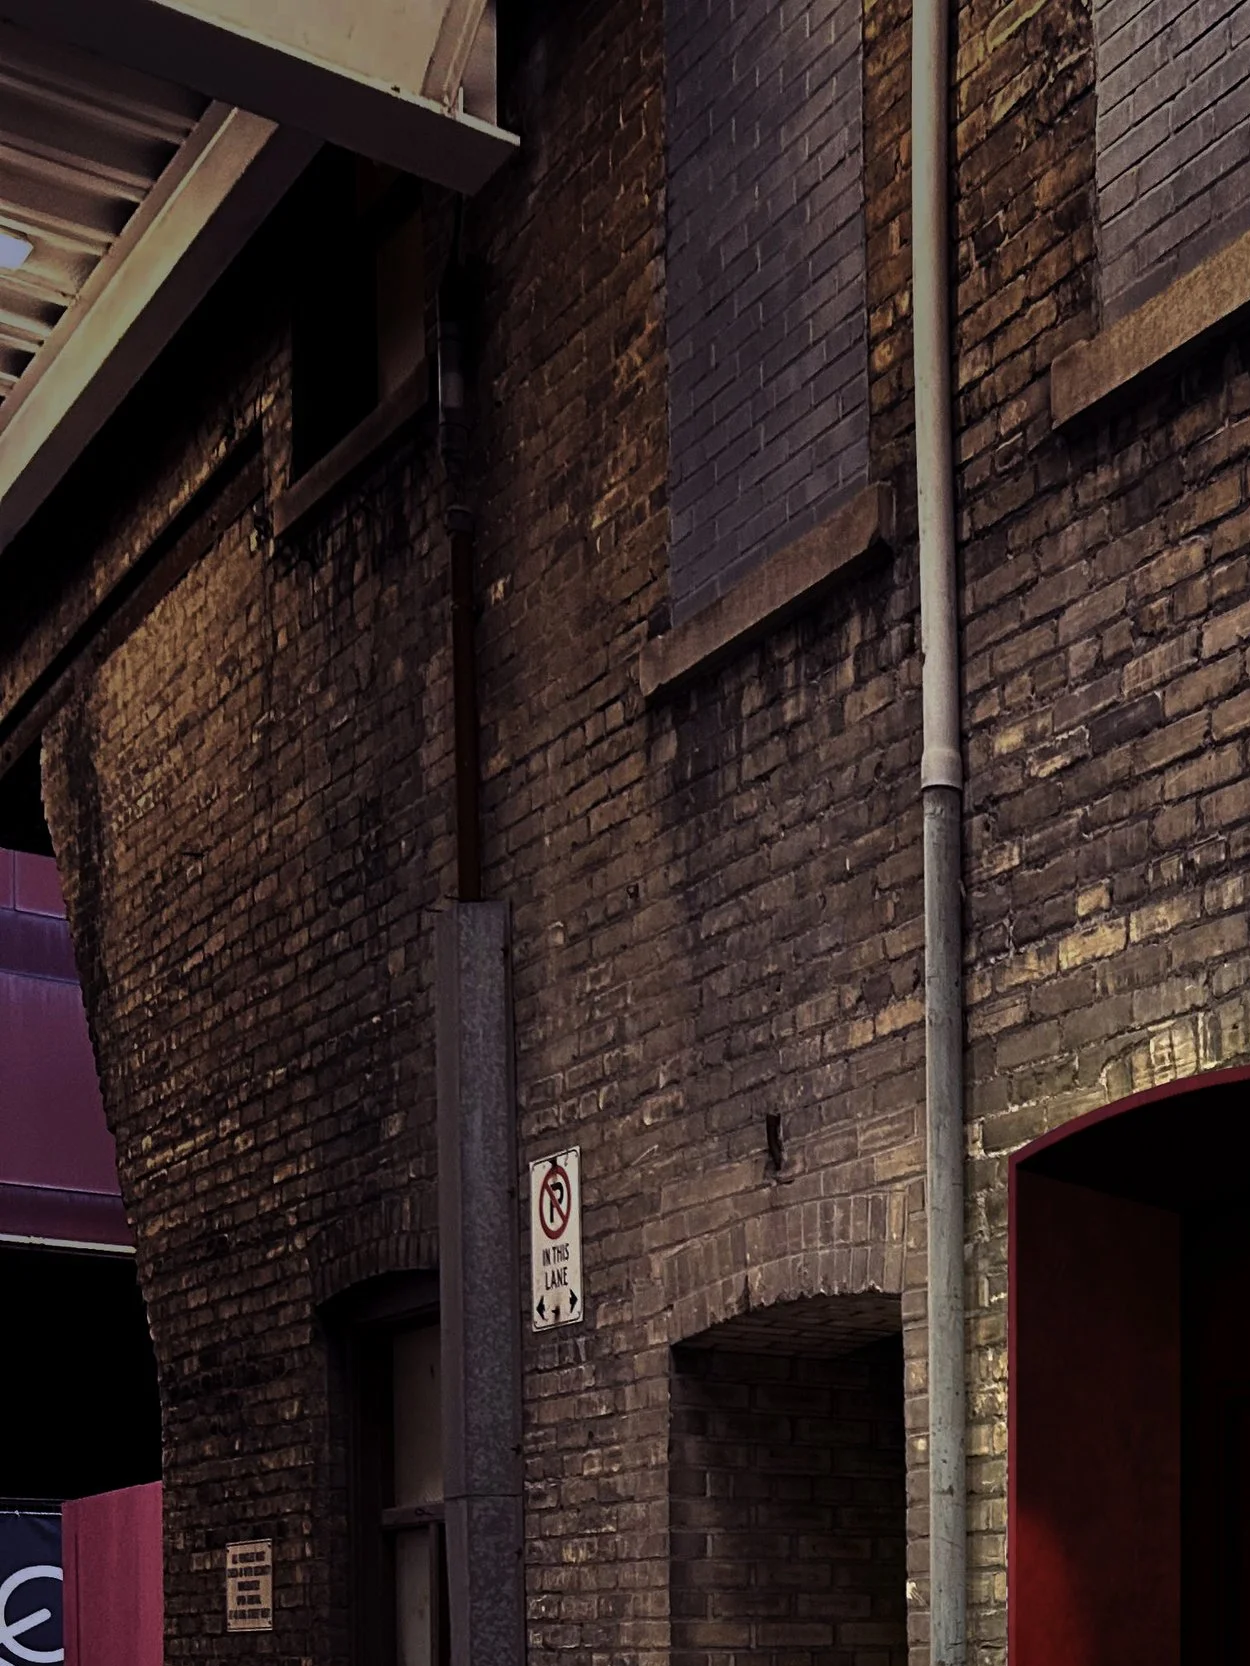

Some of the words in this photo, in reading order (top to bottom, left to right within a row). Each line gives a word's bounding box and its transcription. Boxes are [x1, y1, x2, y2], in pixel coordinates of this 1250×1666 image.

[542, 1248, 551, 1266] IN
[553, 1243, 569, 1264] THIS
[545, 1267, 569, 1290] LANE
